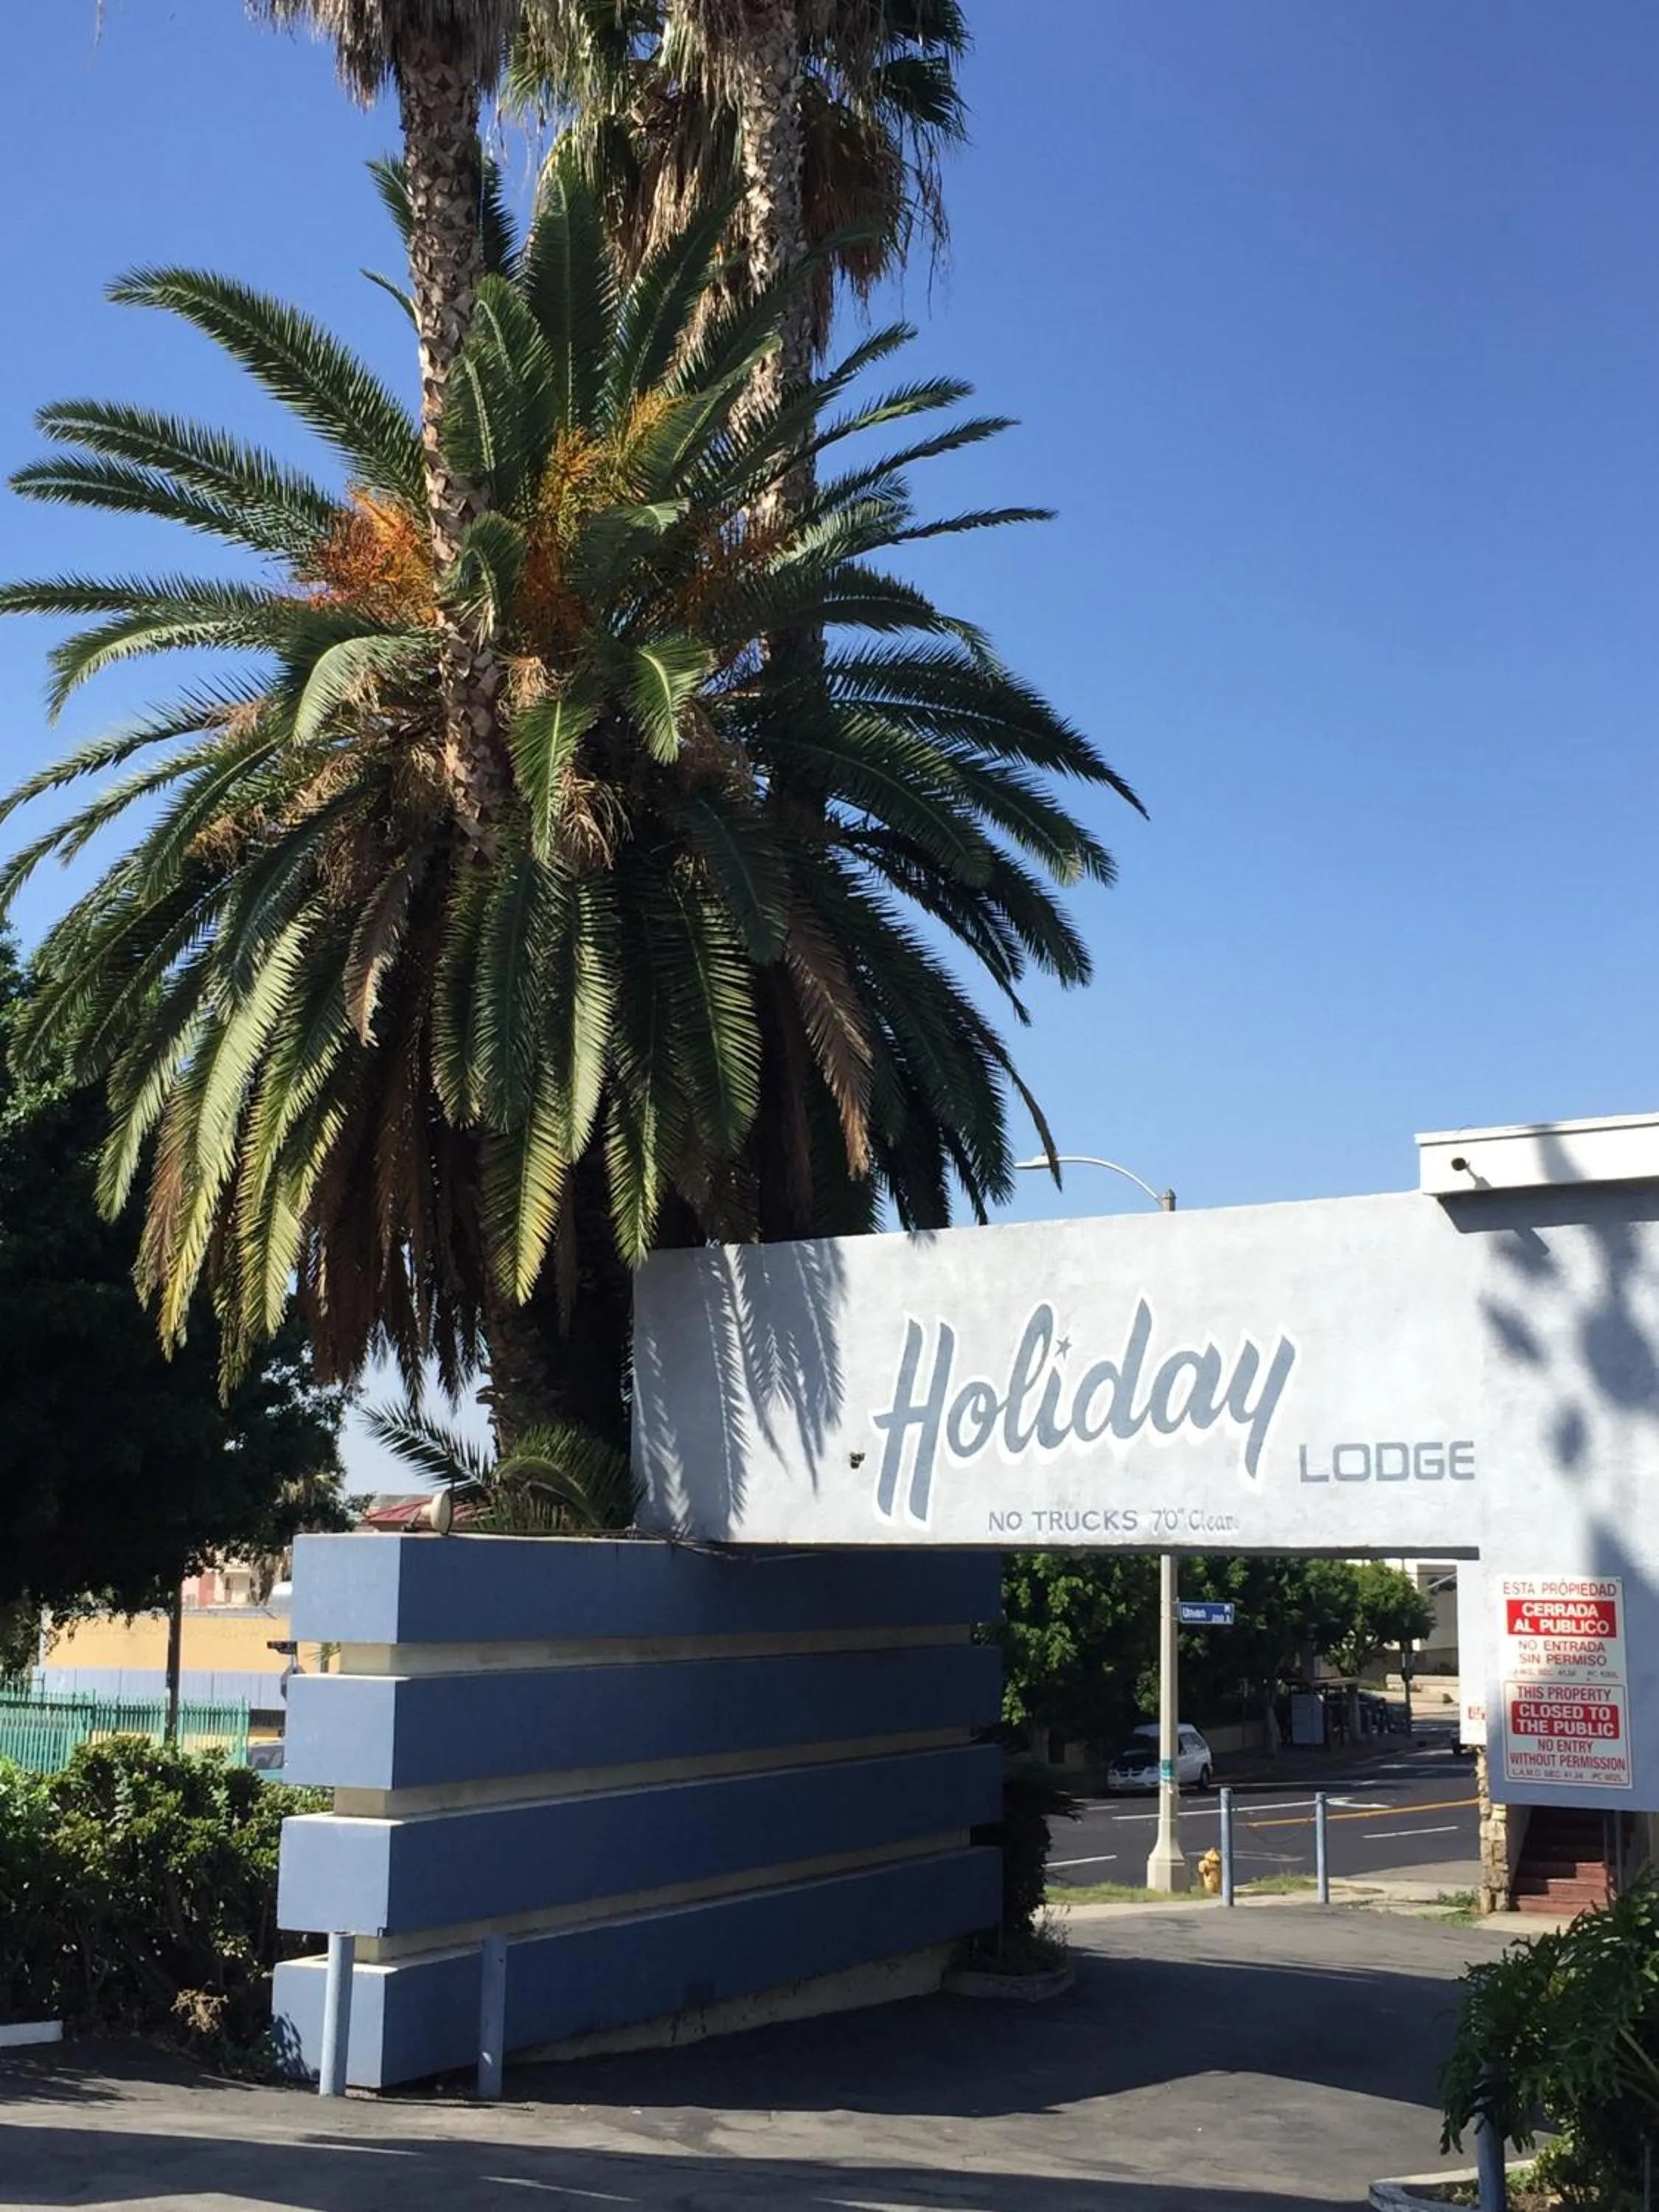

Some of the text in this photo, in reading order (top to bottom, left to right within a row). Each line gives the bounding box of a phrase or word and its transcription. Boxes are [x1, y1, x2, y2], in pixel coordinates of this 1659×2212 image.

[872, 1296, 1296, 1522] Holiday
[1298, 1440, 1475, 1483] LODGE
[988, 1510, 1023, 1531] NO
[1032, 1509, 1138, 1531] TRUCKS
[1503, 1581, 1617, 1597] ESTA PROPIEDAD
[1521, 1602, 1599, 1618] CERRADA
[1514, 1618, 1610, 1635] AL PUBLICO
[1518, 1640, 1606, 1652] NO ENTRADA
[1519, 1654, 1607, 1666] SIN PERMISO
[1517, 1686, 1612, 1701] THIS PROPERTY
[1519, 1703, 1610, 1720] CLOSED TO
[1517, 1719, 1615, 1736] THE PUBLIC
[1537, 1739, 1593, 1753] NO ENTRY
[1509, 1752, 1628, 1770] WITHOUT PERMISSION
